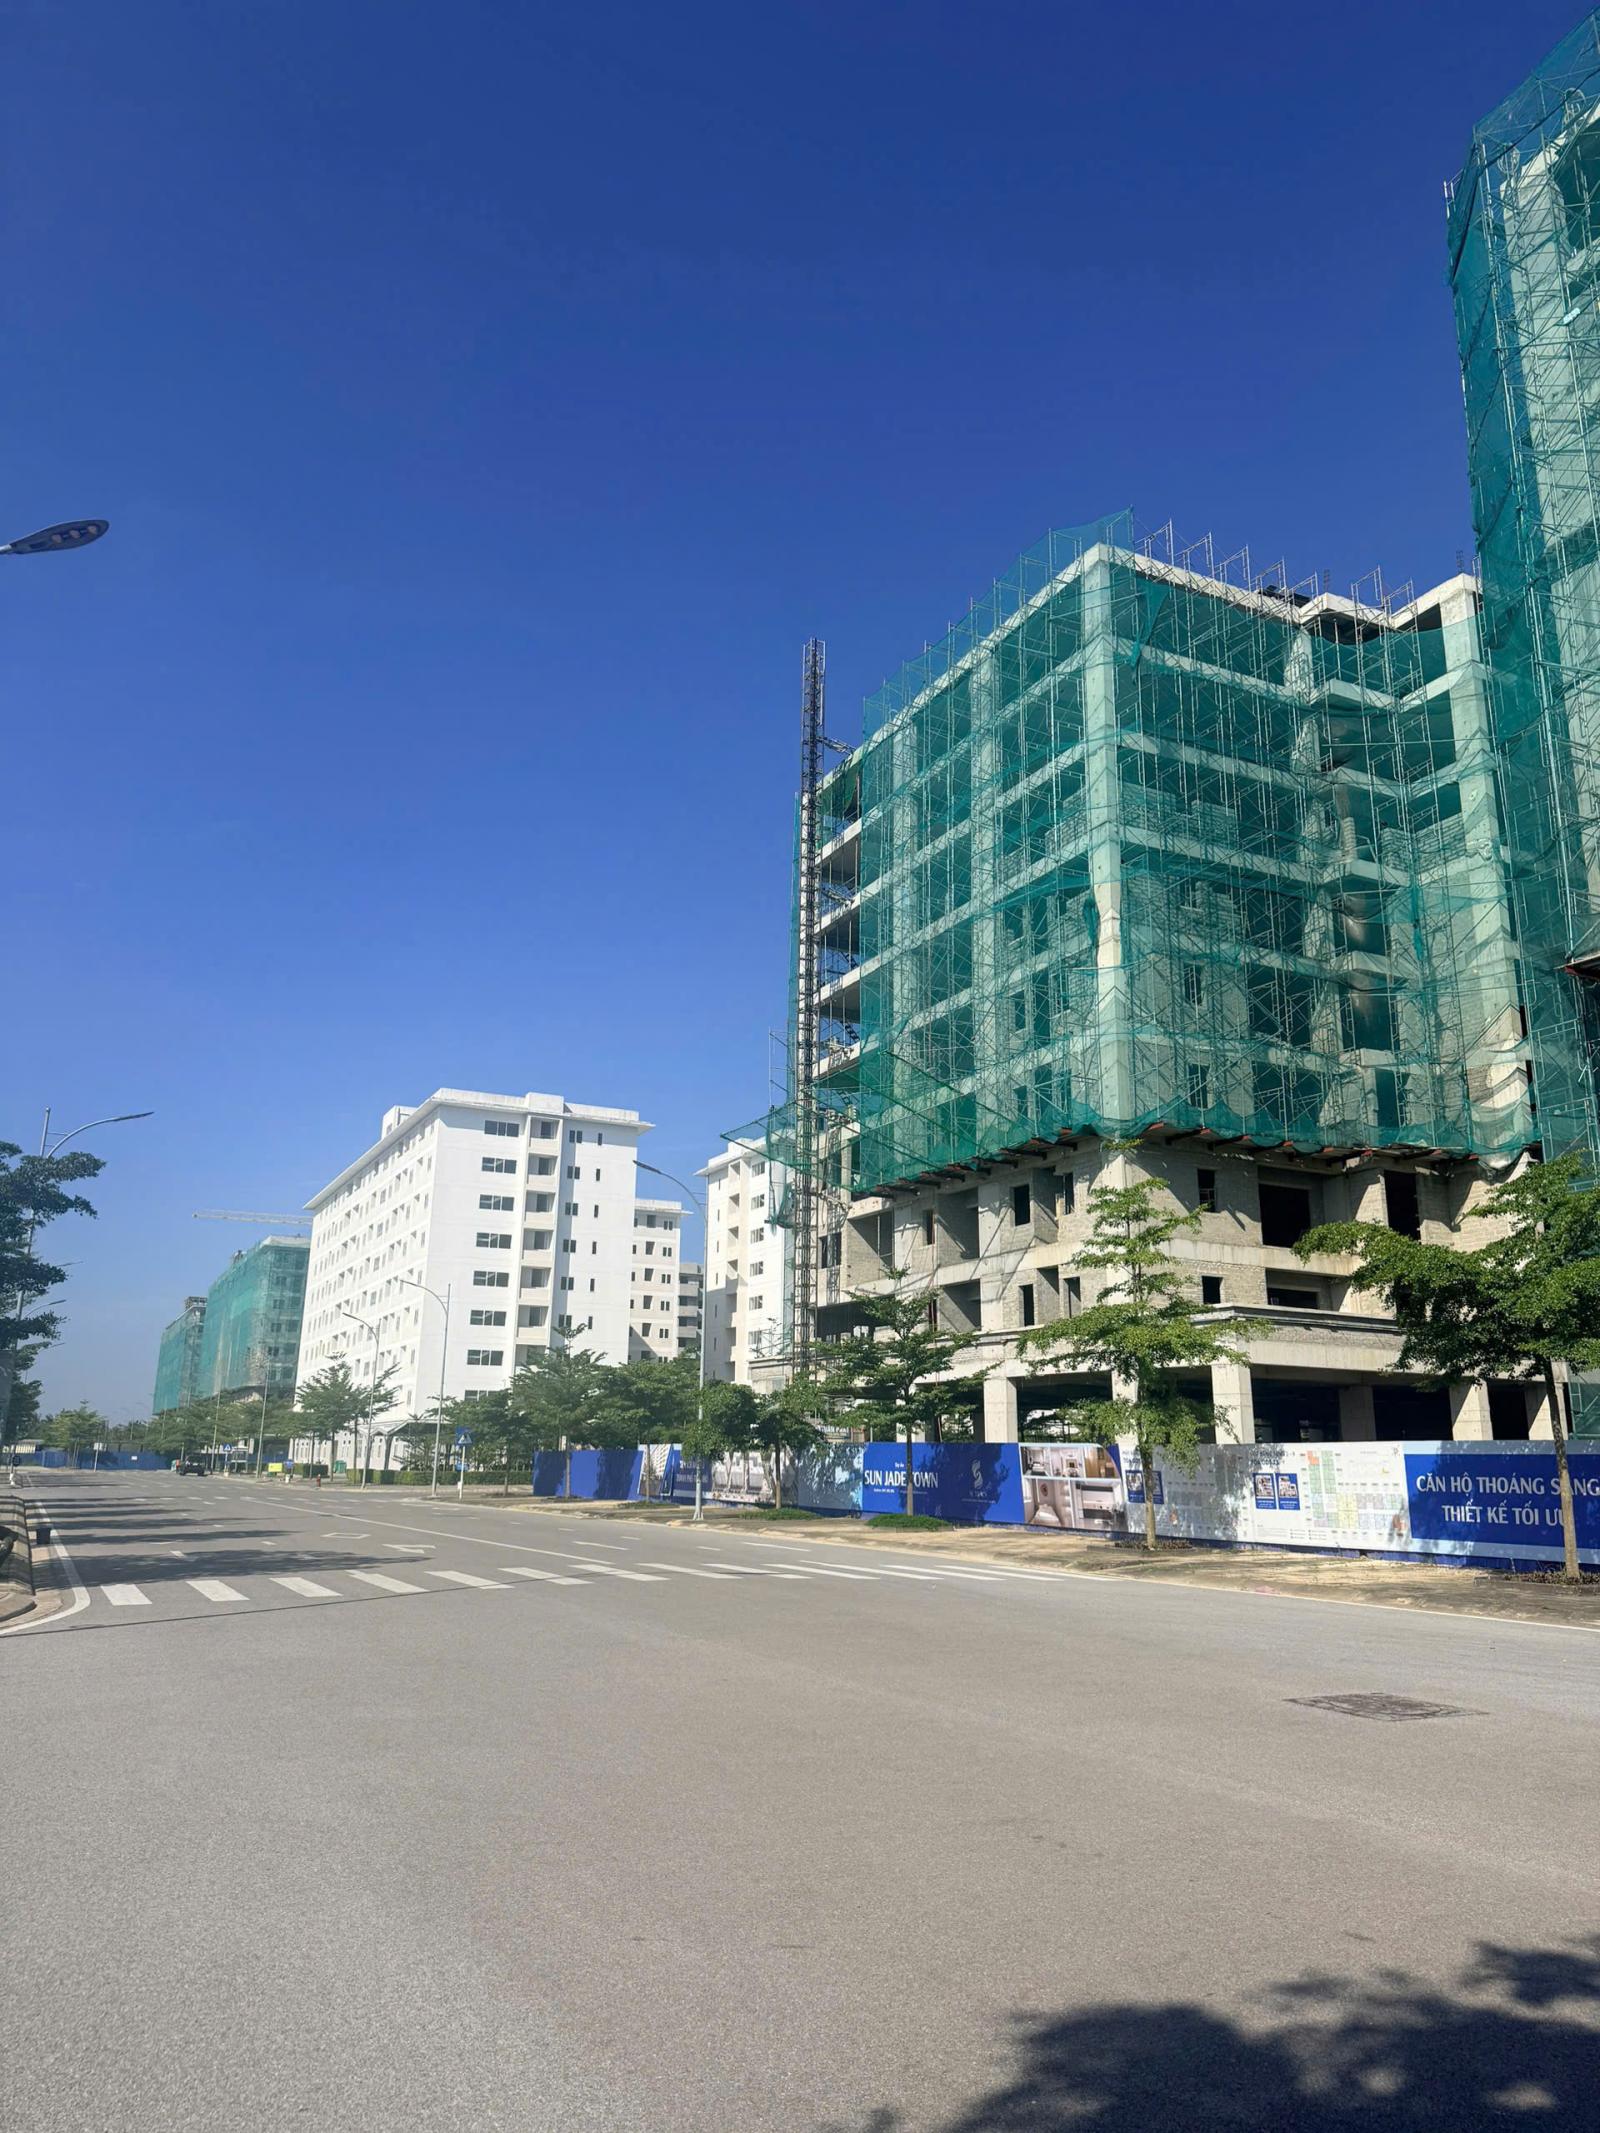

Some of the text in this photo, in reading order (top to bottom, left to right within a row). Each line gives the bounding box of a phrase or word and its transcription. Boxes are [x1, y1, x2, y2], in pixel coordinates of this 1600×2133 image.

[864, 1470, 938, 1489] SUN JADE OWN
[1416, 1472, 1600, 1497] CĂN HỘ THOÁNG SNG
[1442, 1499, 1482, 1524] THIẾT
[1487, 1500, 1509, 1524] KẾ
[1512, 1500, 1539, 1526] TỐI
